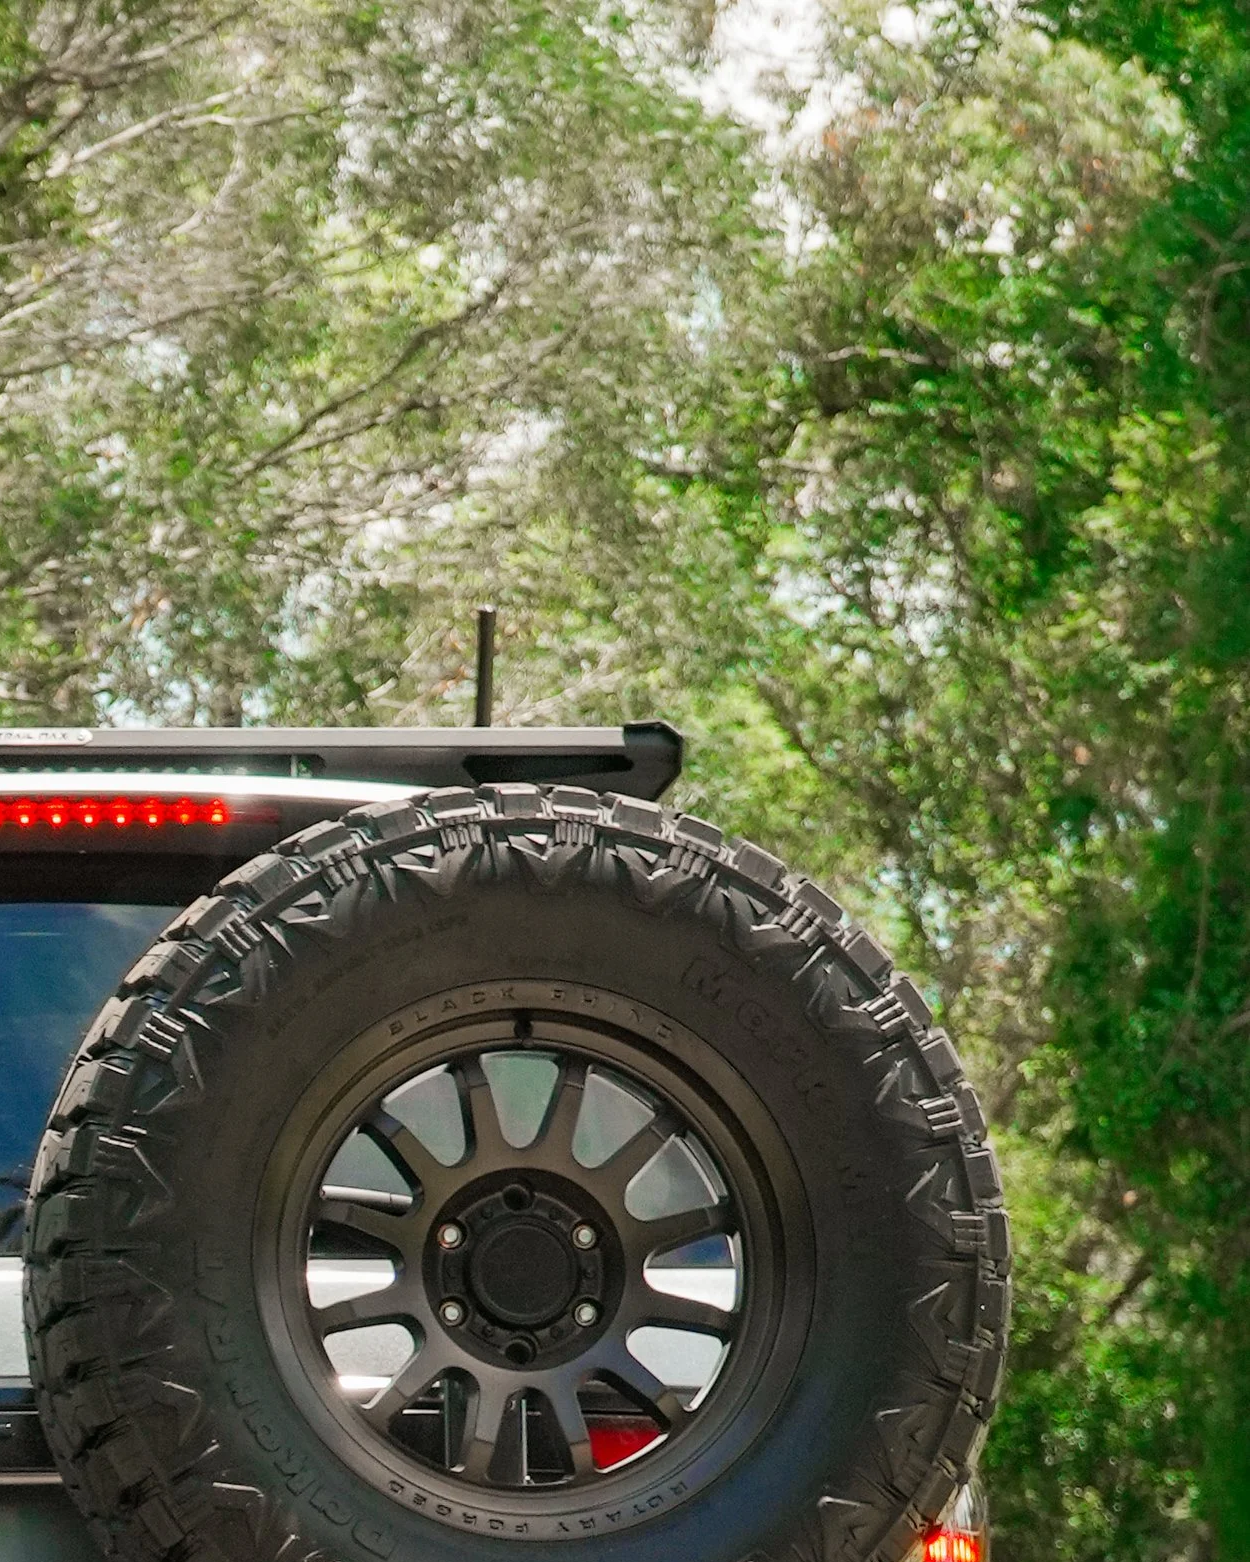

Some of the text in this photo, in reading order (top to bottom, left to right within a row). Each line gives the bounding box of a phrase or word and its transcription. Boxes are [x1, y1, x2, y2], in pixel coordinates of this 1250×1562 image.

[38, 732, 69, 741] MAX
[390, 987, 675, 1040] BLACK RHINO
[388, 1479, 689, 1534] ROTARY FORGED
